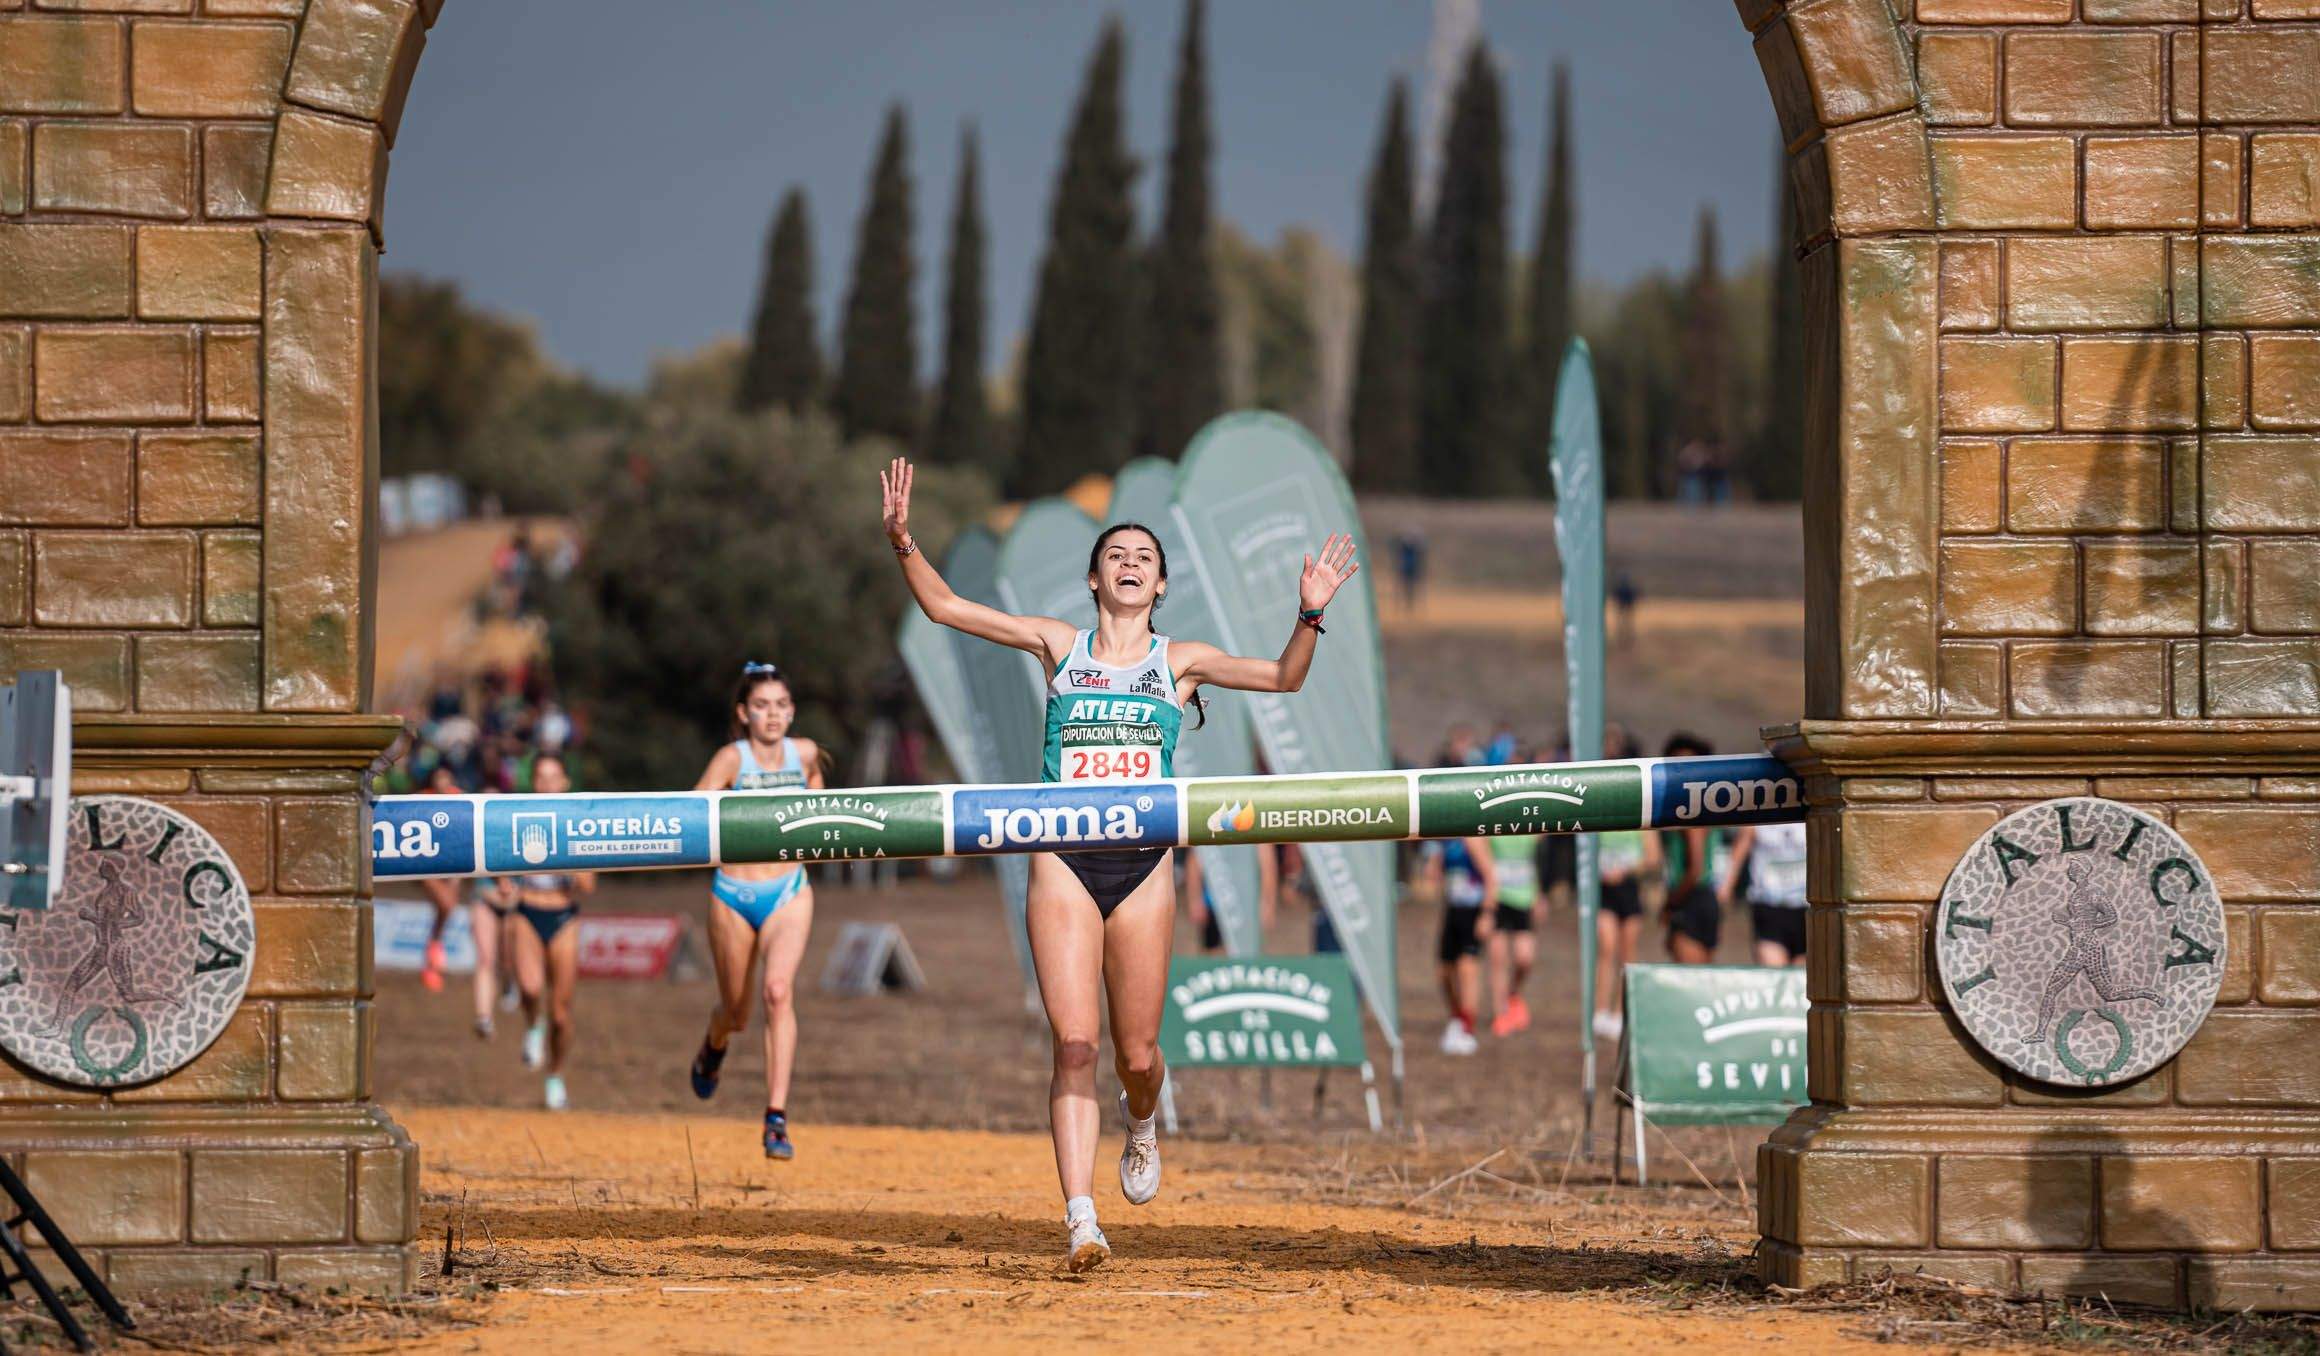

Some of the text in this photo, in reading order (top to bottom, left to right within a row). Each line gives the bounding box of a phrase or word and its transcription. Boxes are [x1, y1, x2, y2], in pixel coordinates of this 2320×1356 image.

[1139, 675, 1162, 685] adidas
[1068, 700, 1157, 723] ATLEET
[1063, 725, 1162, 742] DIPUTACION DE SEVILLA
[1072, 751, 1151, 779] 2849
[1474, 773, 1587, 801] DIPUTACION
[1675, 778, 1802, 819] Jom
[774, 797, 889, 824] DIPUTACION
[1260, 807, 1394, 828] IBERDROLA
[1522, 806, 1539, 815] DE
[566, 814, 682, 837] LOTERÍAS
[823, 830, 840, 841] DE
[1477, 820, 1583, 835] SEVILLA
[580, 842, 670, 852] CON EL DEPORTE
[779, 847, 886, 861] SEVILLA
[1945, 805, 2216, 1000] ITALICA
[1695, 988, 1812, 1027] DIPUTA
[1185, 1030, 1338, 1062] SEVILLA
[1697, 1061, 1808, 1090] SEVI
